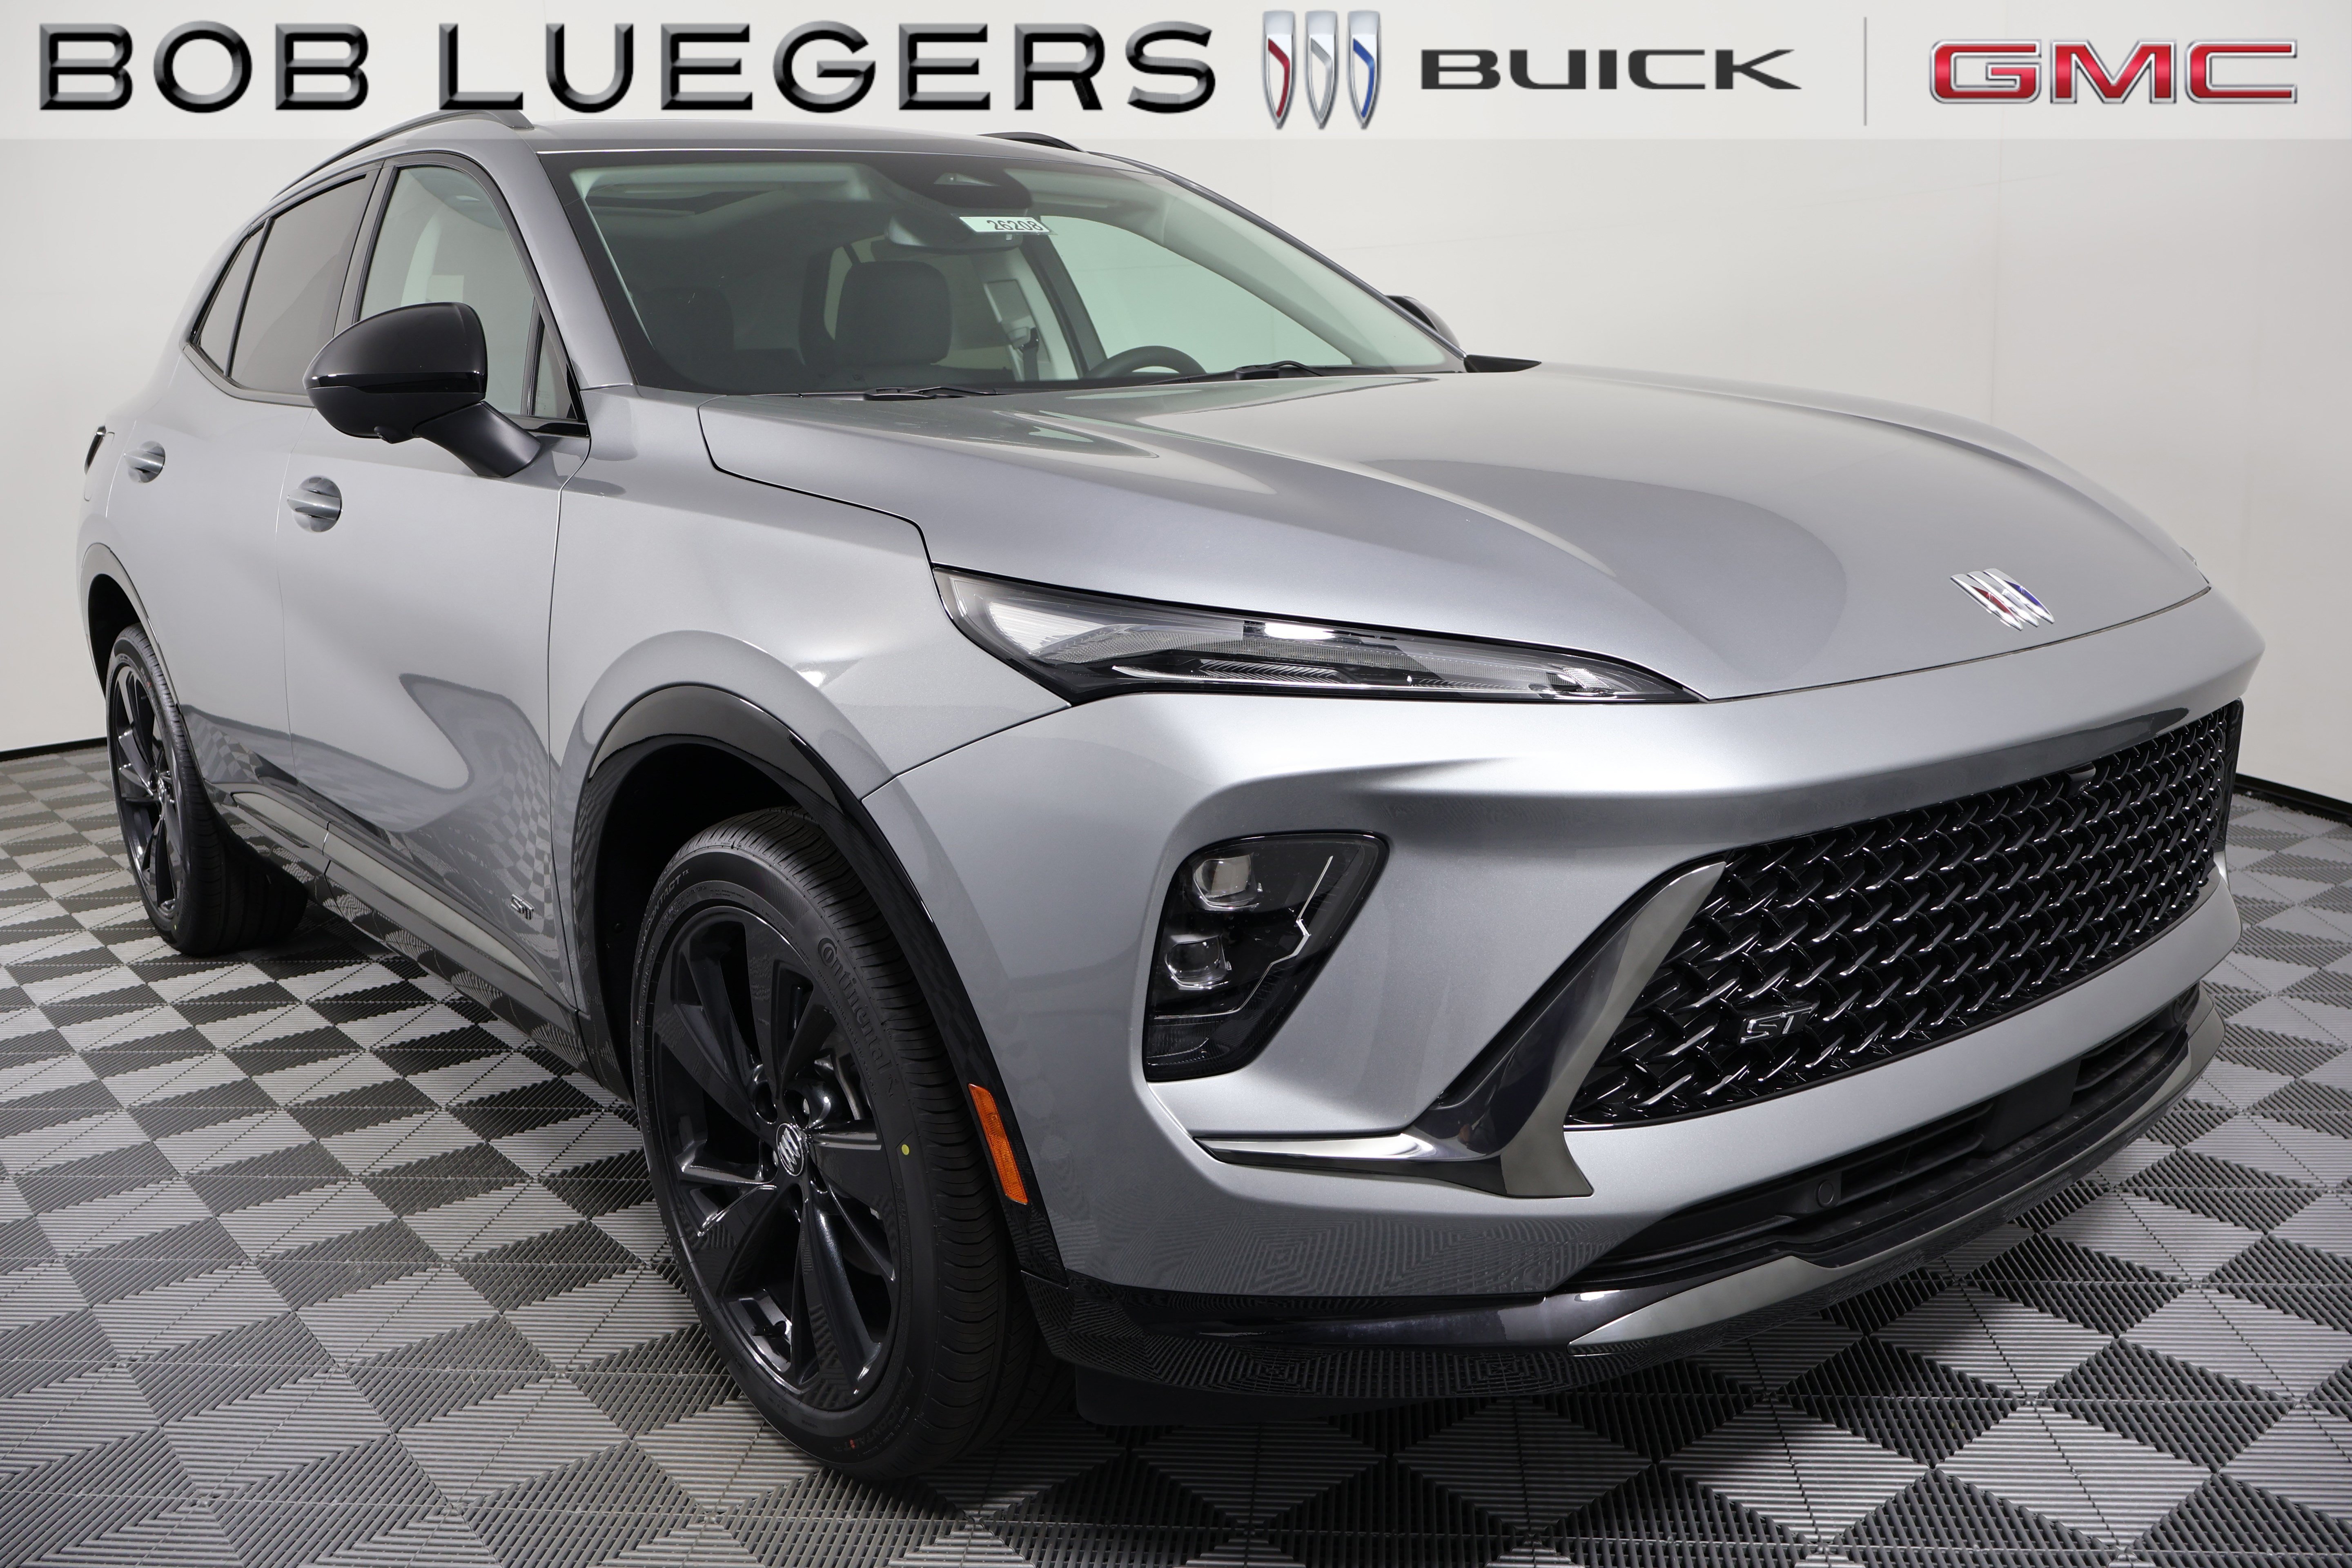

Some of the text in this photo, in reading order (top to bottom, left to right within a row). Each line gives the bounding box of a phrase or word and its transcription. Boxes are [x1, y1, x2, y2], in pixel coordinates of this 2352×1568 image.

[986, 220, 1043, 231] 26208
[817, 937, 893, 1074] Continental
[1740, 1002, 1818, 1044] ST
